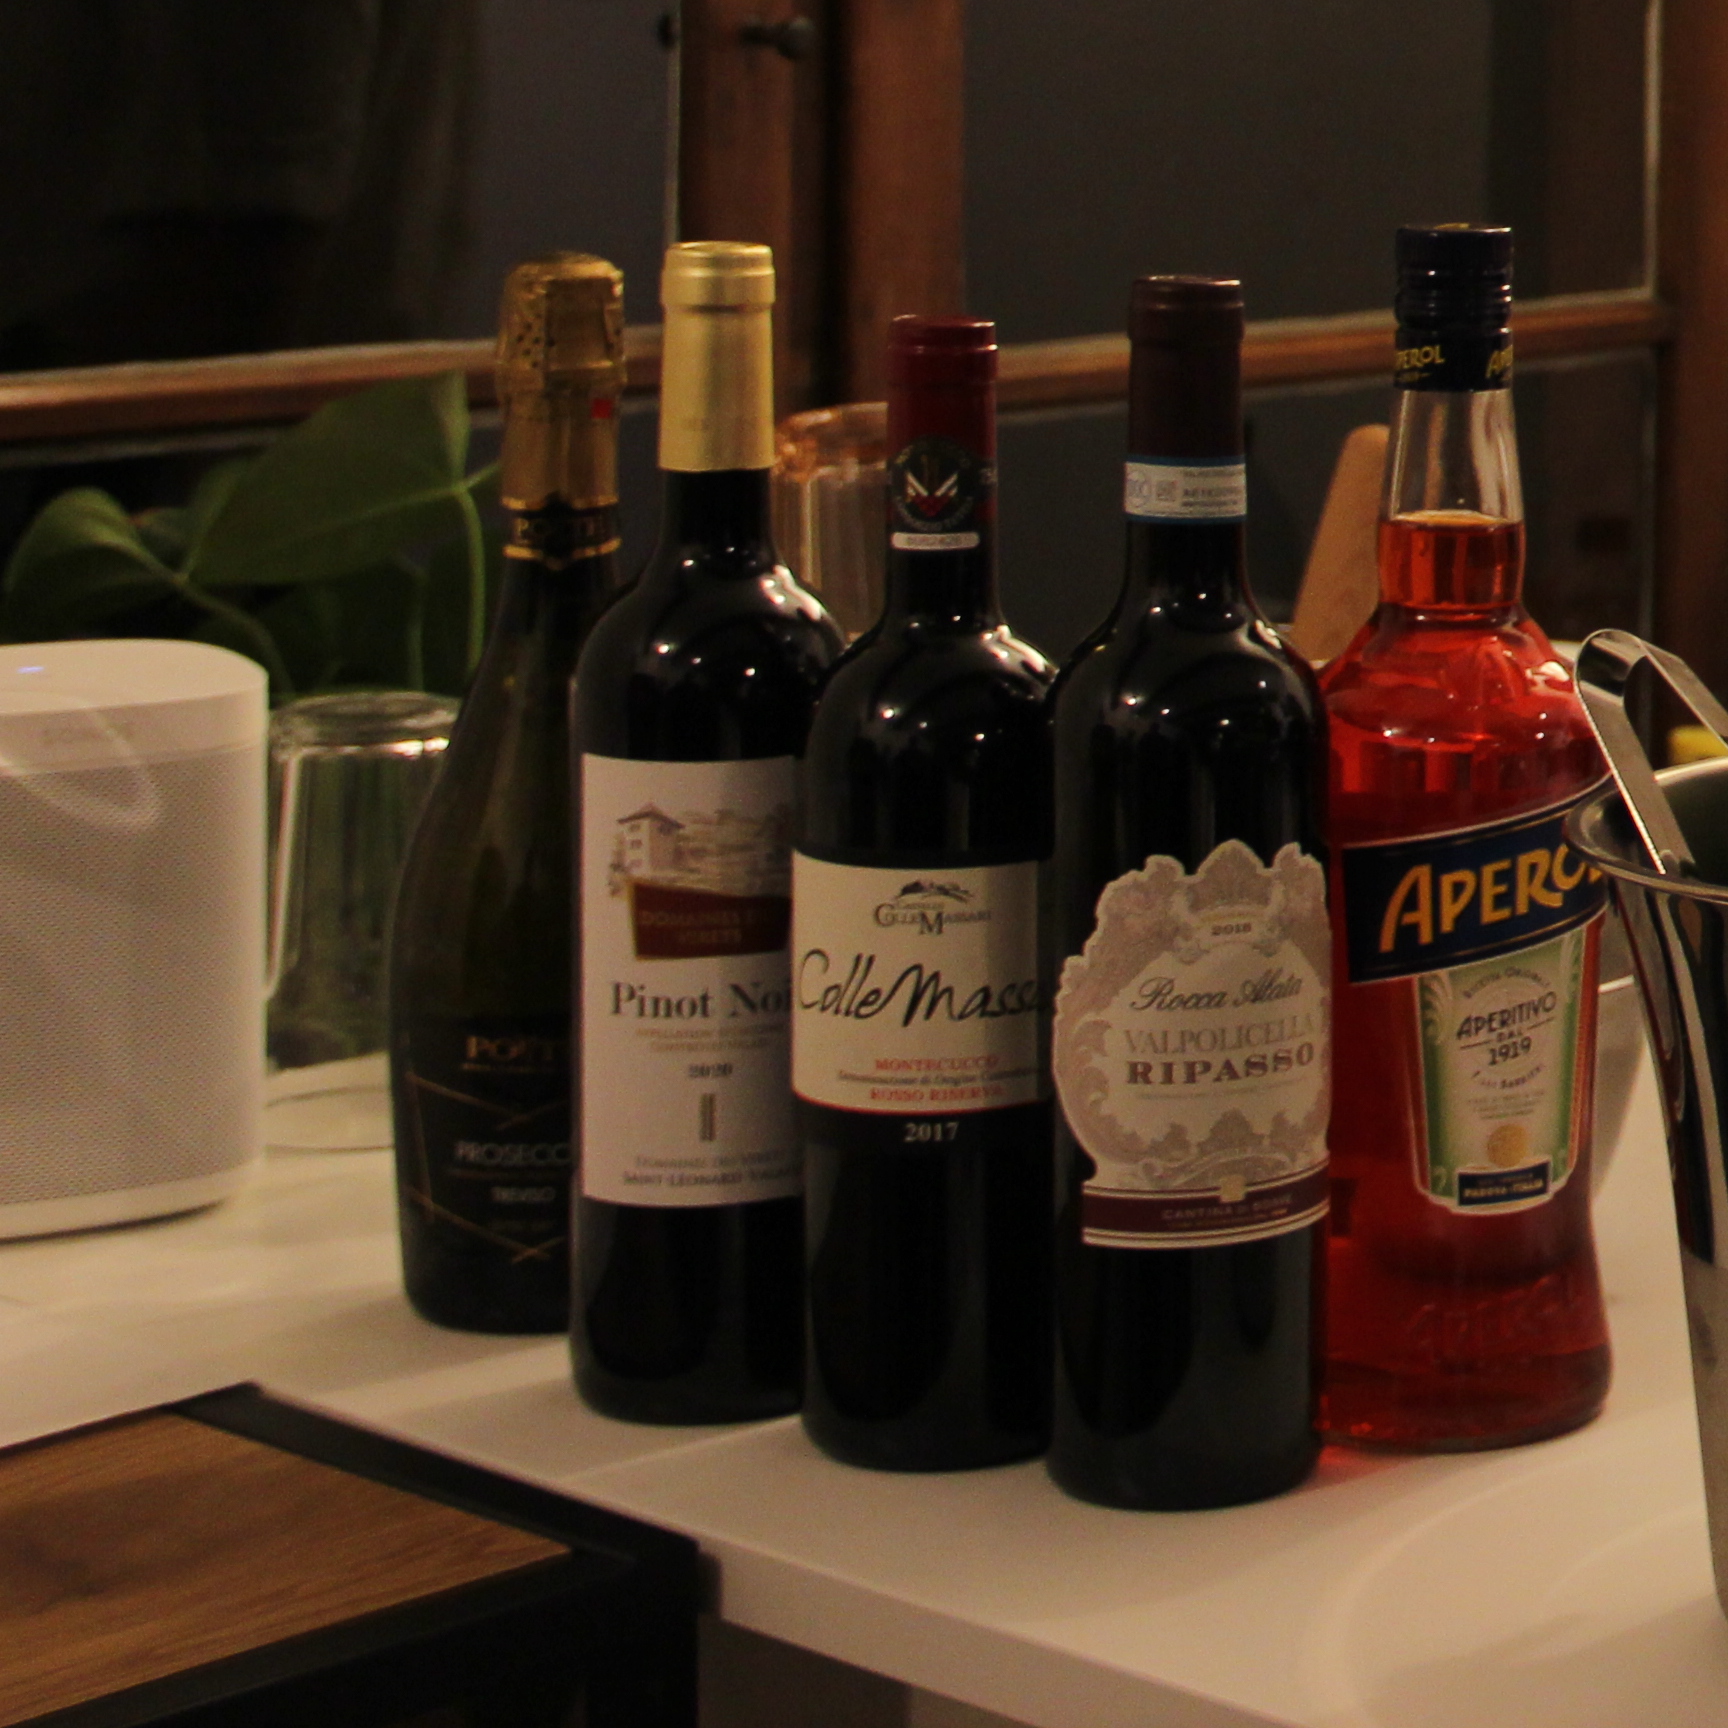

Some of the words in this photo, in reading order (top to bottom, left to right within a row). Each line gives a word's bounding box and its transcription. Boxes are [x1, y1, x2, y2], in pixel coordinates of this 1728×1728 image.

[1395, 343, 1446, 370] PEROL
[1378, 843, 1604, 954] APERO
[609, 981, 712, 1019] Pinot
[729, 981, 791, 1019] Noi
[1129, 976, 1227, 1011] Rocca
[1455, 990, 1558, 1041] APERITIVO
[1123, 1014, 1315, 1055] VALPOLICELLA
[1487, 1036, 1532, 1066] 1919
[875, 1055, 999, 1071] MONTECUCCO
[1126, 1042, 1315, 1086] RIPASSO
[904, 1122, 959, 1143] 2017
